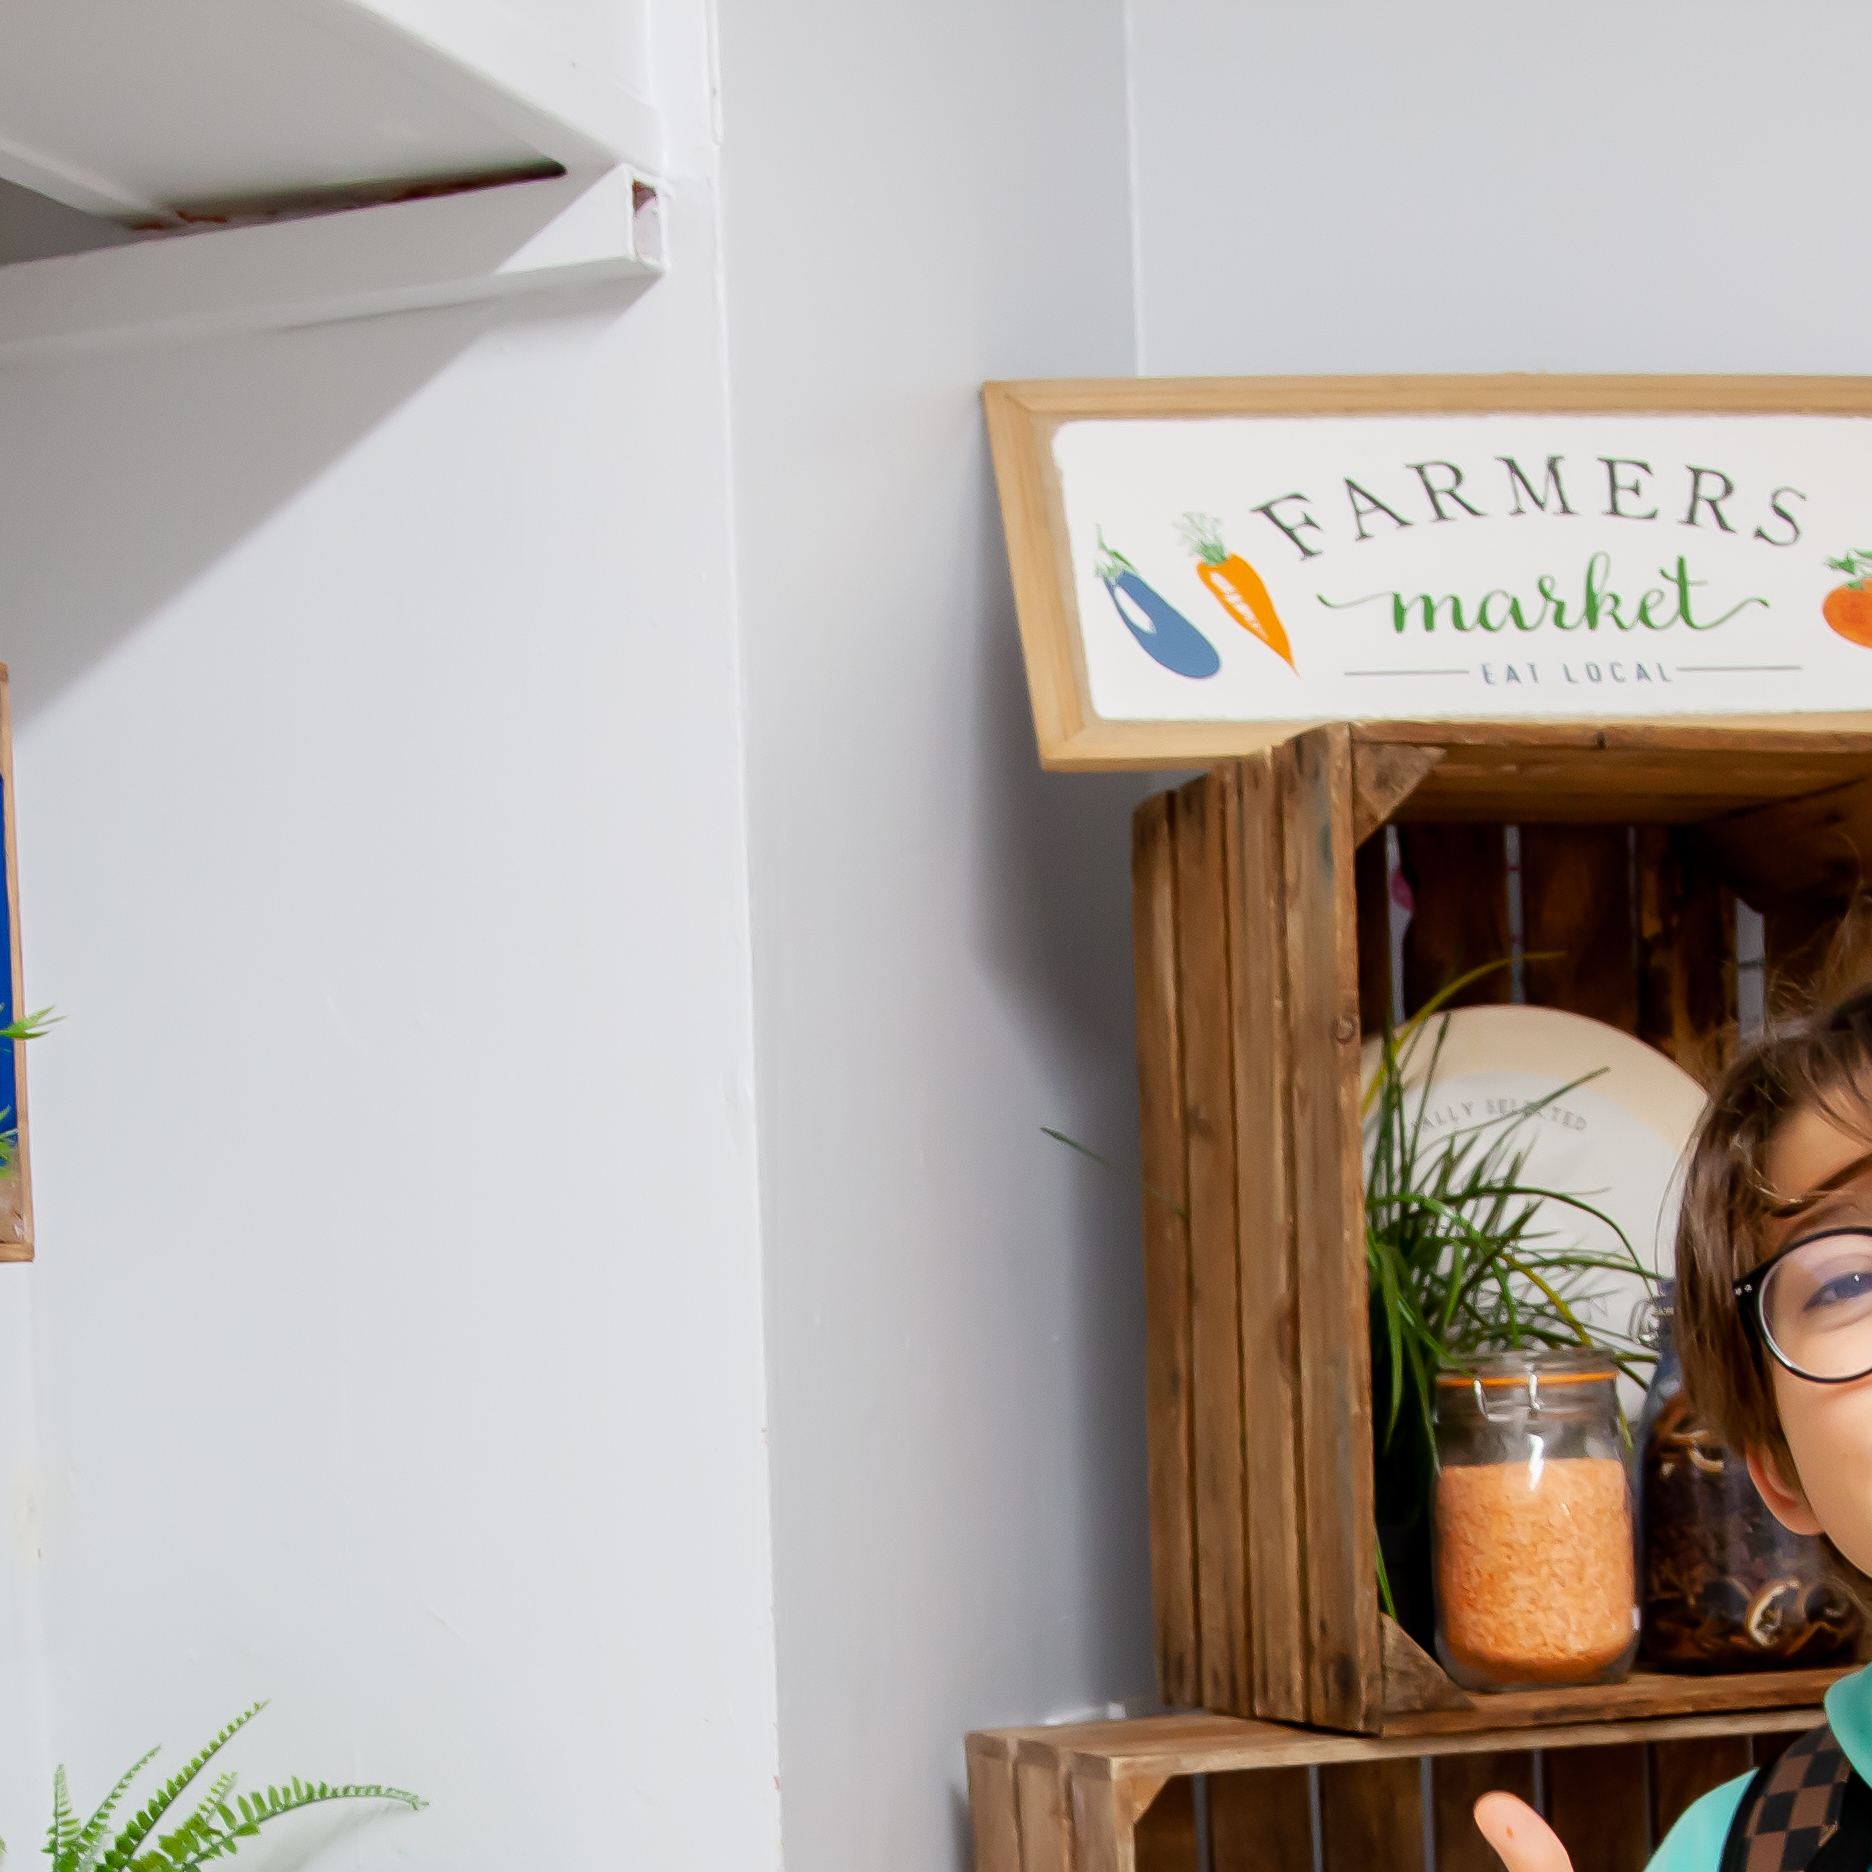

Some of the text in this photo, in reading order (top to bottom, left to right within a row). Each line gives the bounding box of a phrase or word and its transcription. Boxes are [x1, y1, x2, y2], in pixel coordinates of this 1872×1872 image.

[1250, 454, 1809, 563] FARMERS
[1317, 551, 1770, 638] market
[1480, 659, 1674, 688] EAT LOCAL
